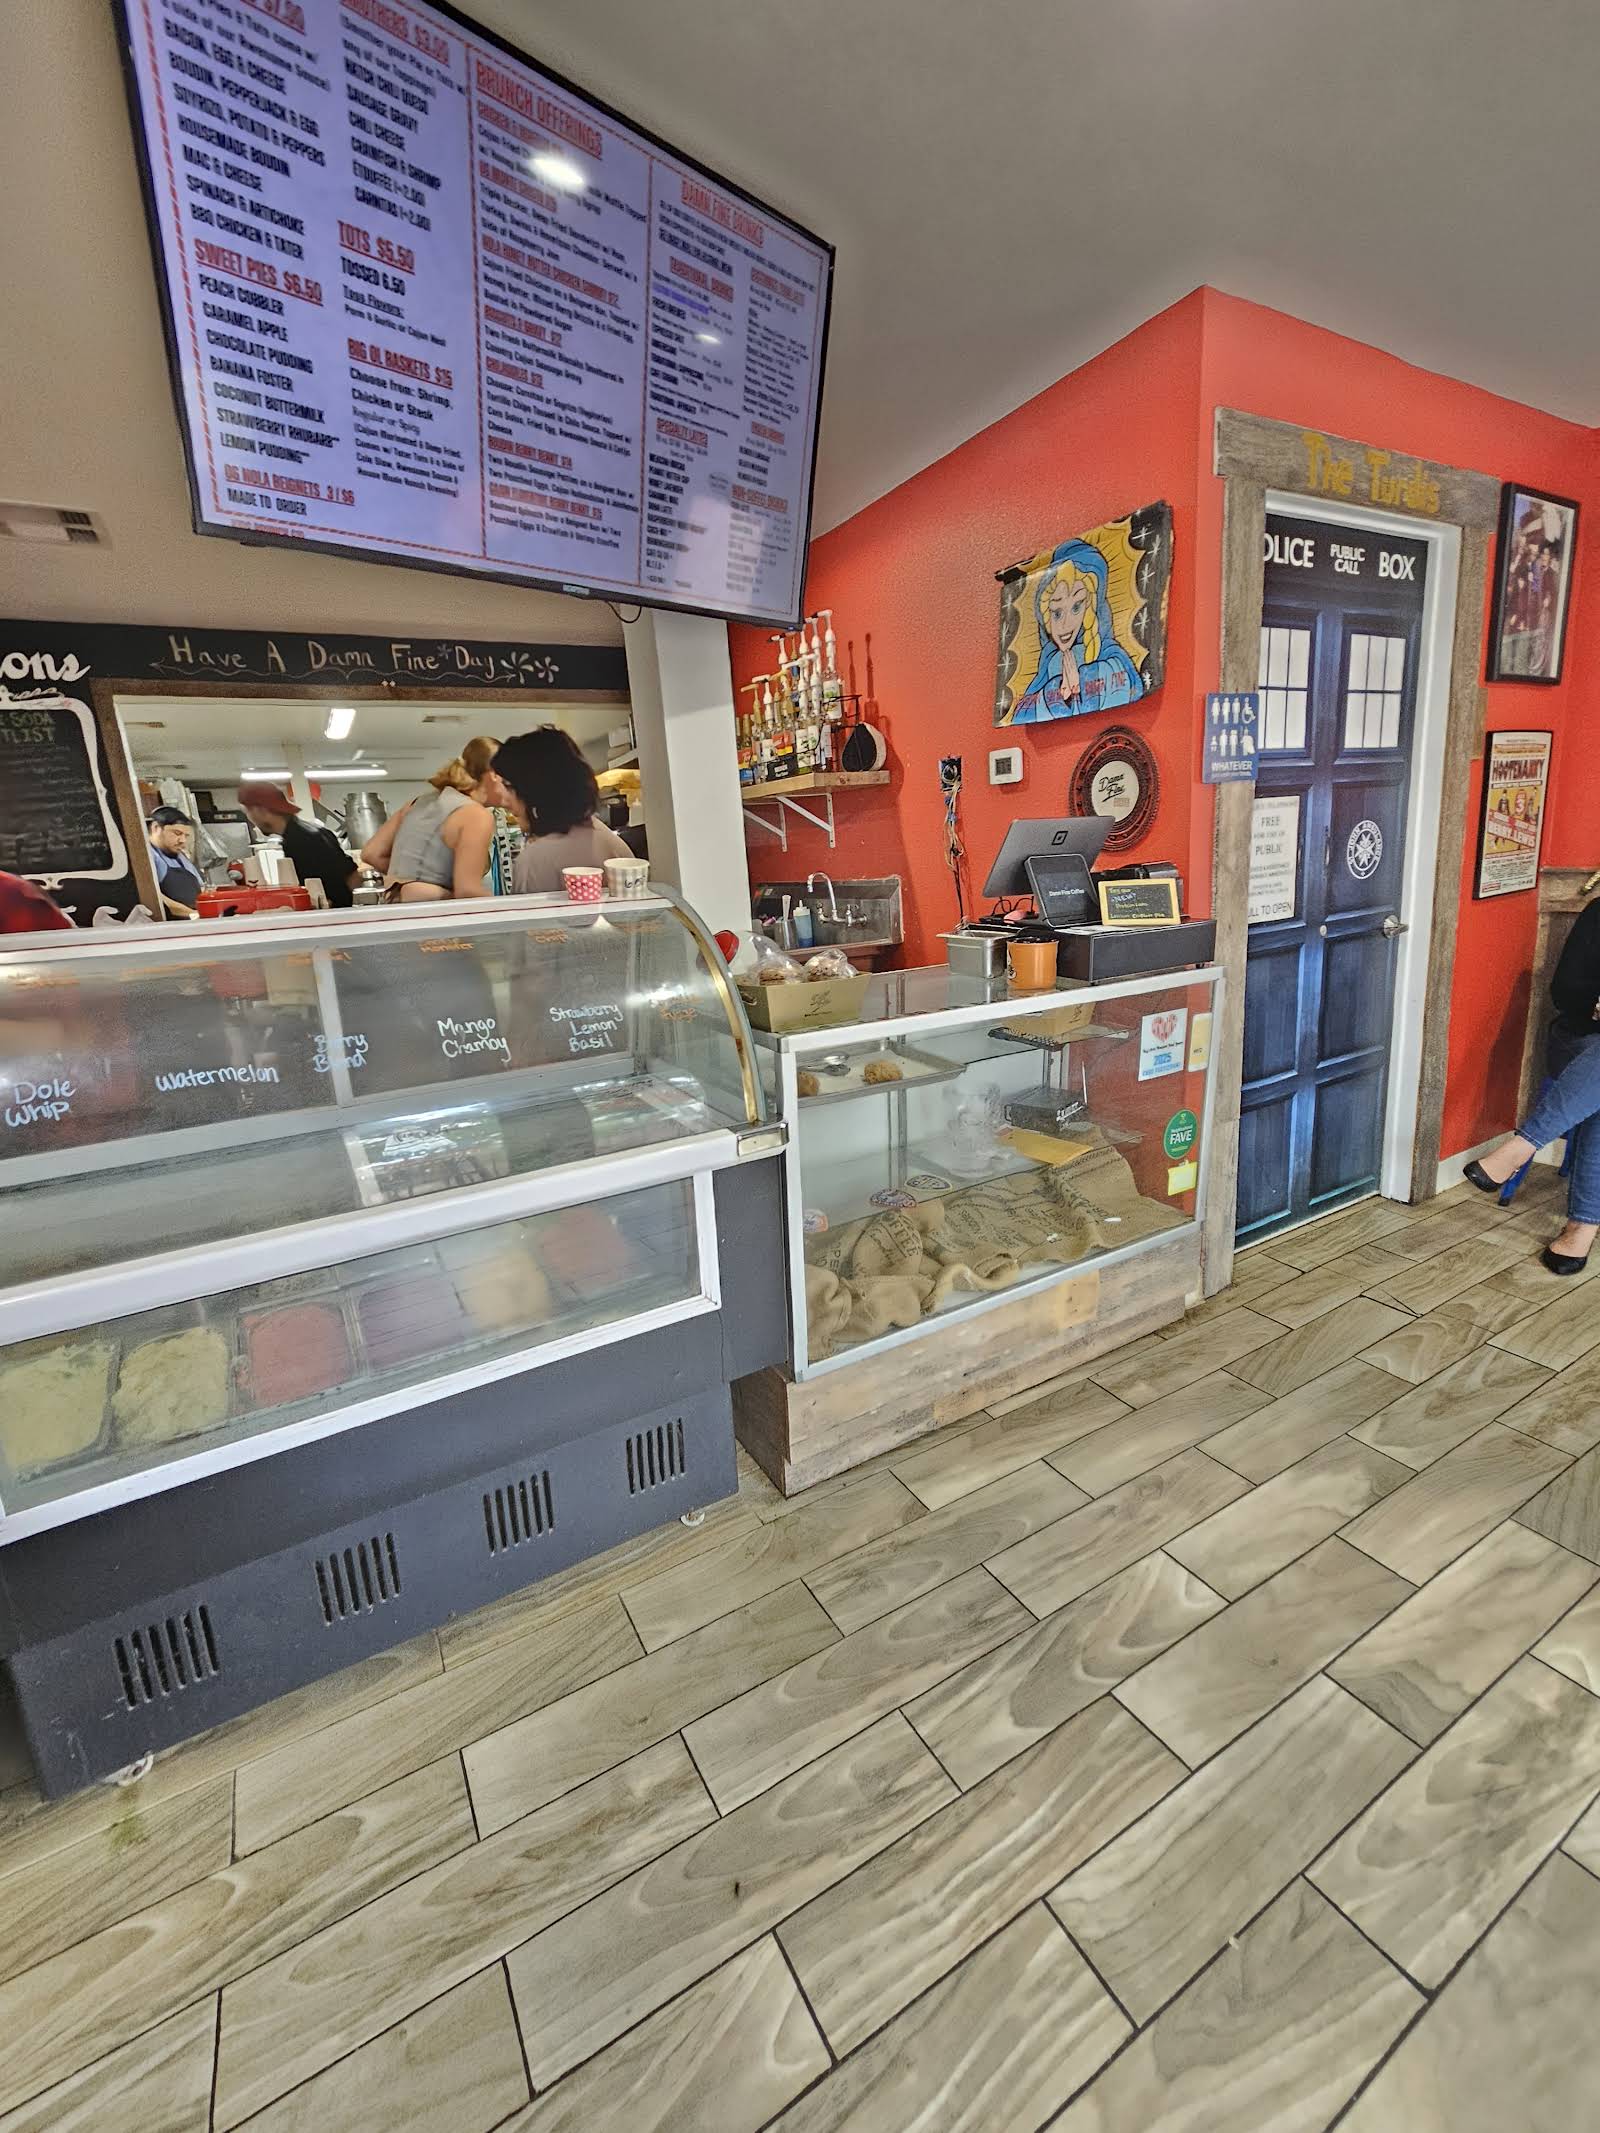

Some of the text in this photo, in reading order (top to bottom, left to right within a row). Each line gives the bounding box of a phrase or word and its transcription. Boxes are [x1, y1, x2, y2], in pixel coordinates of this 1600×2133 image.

[164, 19, 209, 55] BACON,
[212, 43, 233, 67] EGG
[248, 61, 285, 93] CHEESE
[169, 52, 217, 89] BOUDIN,
[220, 76, 286, 121] PEPPERJACK
[300, 115, 319, 136] EGG
[347, 85, 417, 132] SAUSAGE GRAVY
[476, 60, 531, 116] BRUNCH
[538, 97, 601, 156] OFFERINGS
[178, 115, 289, 176] HOUSEMADE BOUDIN
[229, 110, 268, 140] POTATO
[282, 134, 325, 166] PEPPERS
[375, 124, 404, 150] CHEESE
[183, 146, 210, 169] MAC
[224, 163, 262, 191] CHEESE
[352, 137, 397, 169] CRAWFISH
[408, 165, 439, 190] SHRIMP
[186, 175, 235, 207] SPINACH
[249, 201, 303, 233] ARTICHOKE
[355, 187, 396, 215] CARNITAS
[191, 205, 213, 225] BBQ
[216, 214, 262, 243] CHICKEN
[275, 237, 303, 259] TATER
[339, 221, 413, 268] TOTS $5.50
[194, 239, 321, 301] SWEET PIES $6.50
[341, 257, 404, 294] TOSSED 6.50
[199, 275, 283, 314] PEACH COBBLER
[203, 303, 287, 341] CARAMEL APPLE
[207, 330, 312, 372] CHOCOLATE PUDDING
[348, 339, 366, 358] BIG
[385, 351, 429, 378] BASKETS
[435, 367, 451, 385] $15
[210, 357, 292, 391] BANANA FOSTER
[351, 368, 386, 387] Choose
[418, 389, 452, 408] Shrimp,
[214, 383, 324, 422] COCONUT BUTTERMILK
[217, 409, 285, 435] STRAWBERRY
[353, 390, 432, 420] Chicken or Steak
[220, 433, 255, 452] LEMON
[225, 465, 239, 480] OG
[242, 468, 269, 486] NOLA
[273, 475, 319, 496] BEIGNETS
[1303, 432, 1353, 496] The
[228, 489, 306, 514] MADE TO ORDER
[1264, 535, 1415, 580] OLICE PUBLIC BOX
[1334, 559, 1360, 575] CALL
[0, 651, 91, 682] ons
[169, 635, 494, 677] Have A Damn Fine Day
[1211, 761, 1253, 772] WHATEVER
[550, 1004, 624, 1023] Strawberry
[570, 1018, 618, 1037] Lemon
[569, 1033, 614, 1053] Basil
[15, 1077, 76, 1104] Dole
[5, 1098, 70, 1128] Whip
[1169, 1130, 1192, 1145] FAVE
